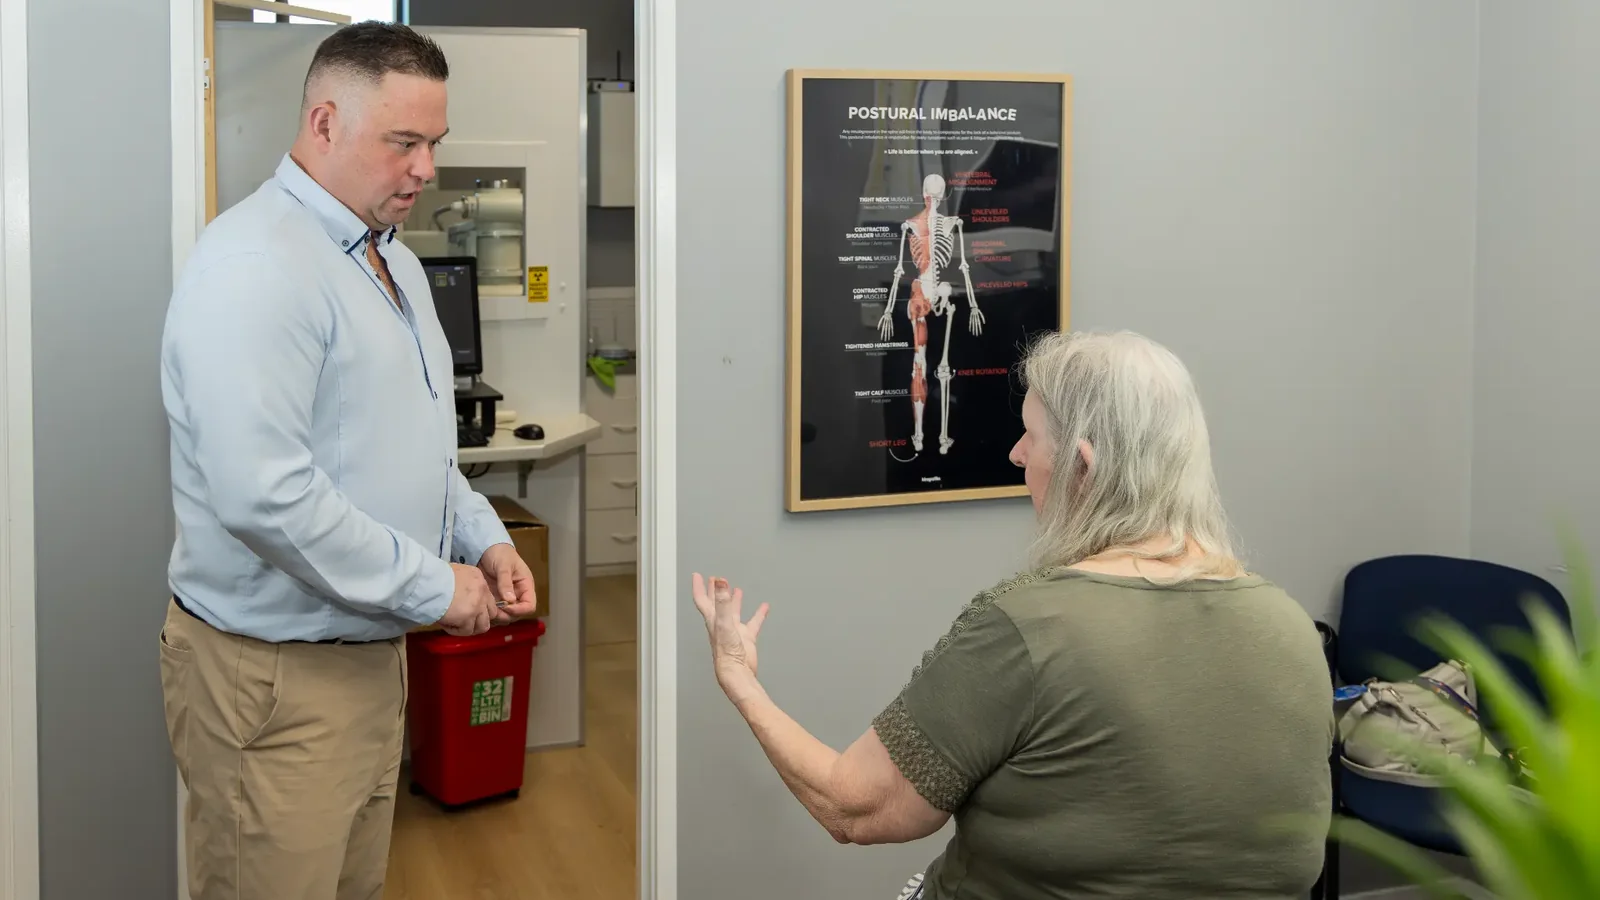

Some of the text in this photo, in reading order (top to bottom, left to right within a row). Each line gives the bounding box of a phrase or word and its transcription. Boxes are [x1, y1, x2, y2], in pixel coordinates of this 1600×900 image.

[848, 106, 1017, 121] POSTURAL IMBALANCE
[976, 367, 1007, 375] ROTATION
[481, 680, 502, 696] 32
[480, 695, 501, 706] LTR
[479, 709, 501, 723] BIN
